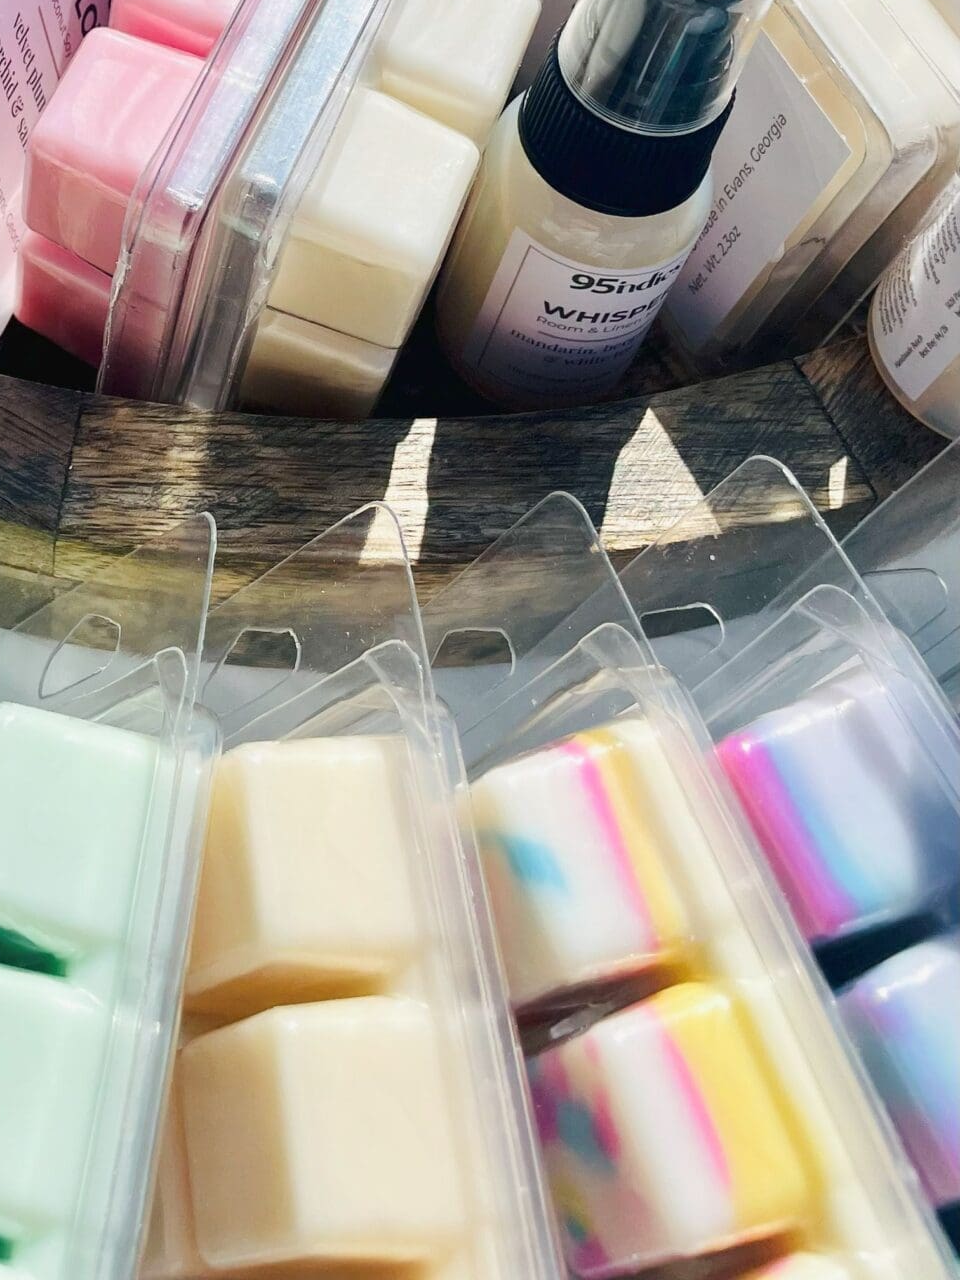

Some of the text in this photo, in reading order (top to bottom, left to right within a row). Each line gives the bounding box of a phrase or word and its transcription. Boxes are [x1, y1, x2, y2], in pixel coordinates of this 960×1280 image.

[13, 11, 36, 73] velvet
[723, 163, 755, 201] Evans,
[749, 113, 788, 162] Georgia
[535, 315, 584, 334] Room
